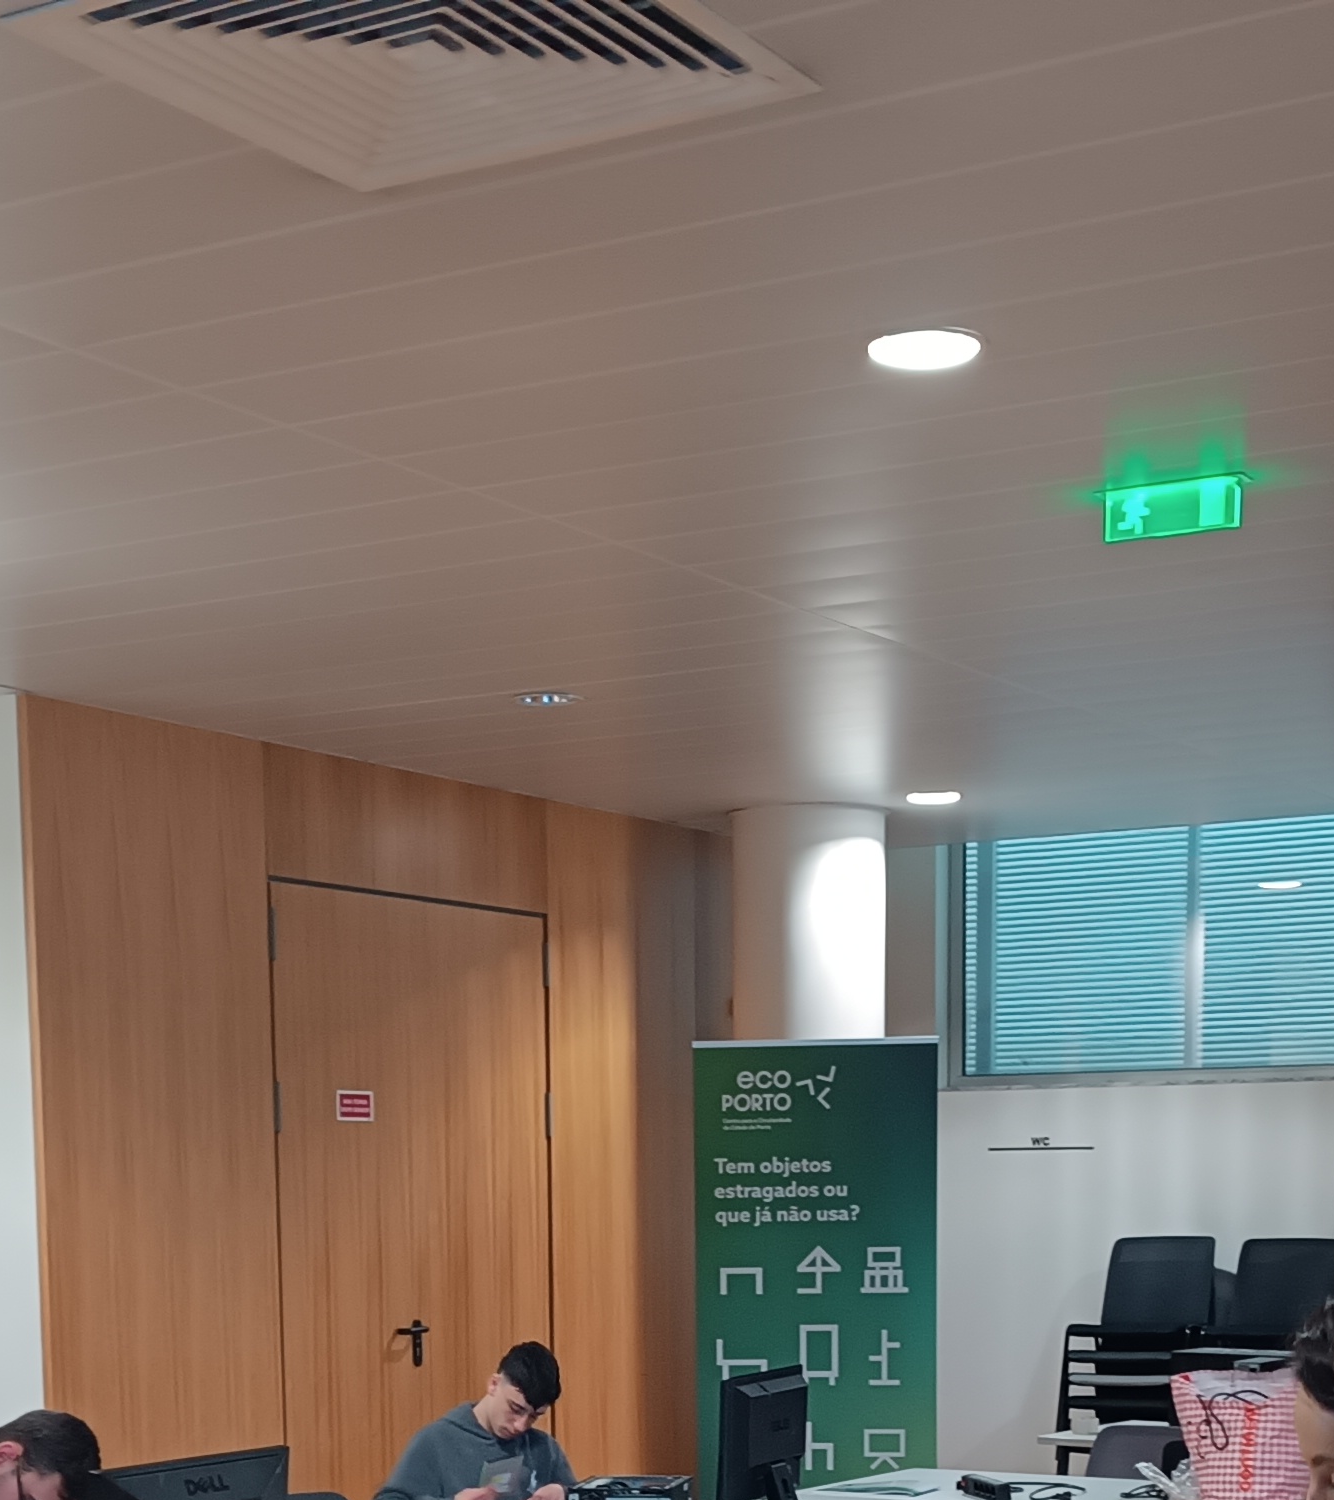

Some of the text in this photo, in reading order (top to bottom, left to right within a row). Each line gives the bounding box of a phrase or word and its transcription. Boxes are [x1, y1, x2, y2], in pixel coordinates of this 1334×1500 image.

[736, 1070, 792, 1089] eco
[721, 1093, 792, 1112] PORTO
[1030, 1136, 1051, 1147] WC
[714, 1156, 832, 1178] Tem objetos
[714, 1181, 848, 1202] estragados ou
[715, 1204, 861, 1227] que já não usa?
[184, 1474, 230, 1496] DELL
